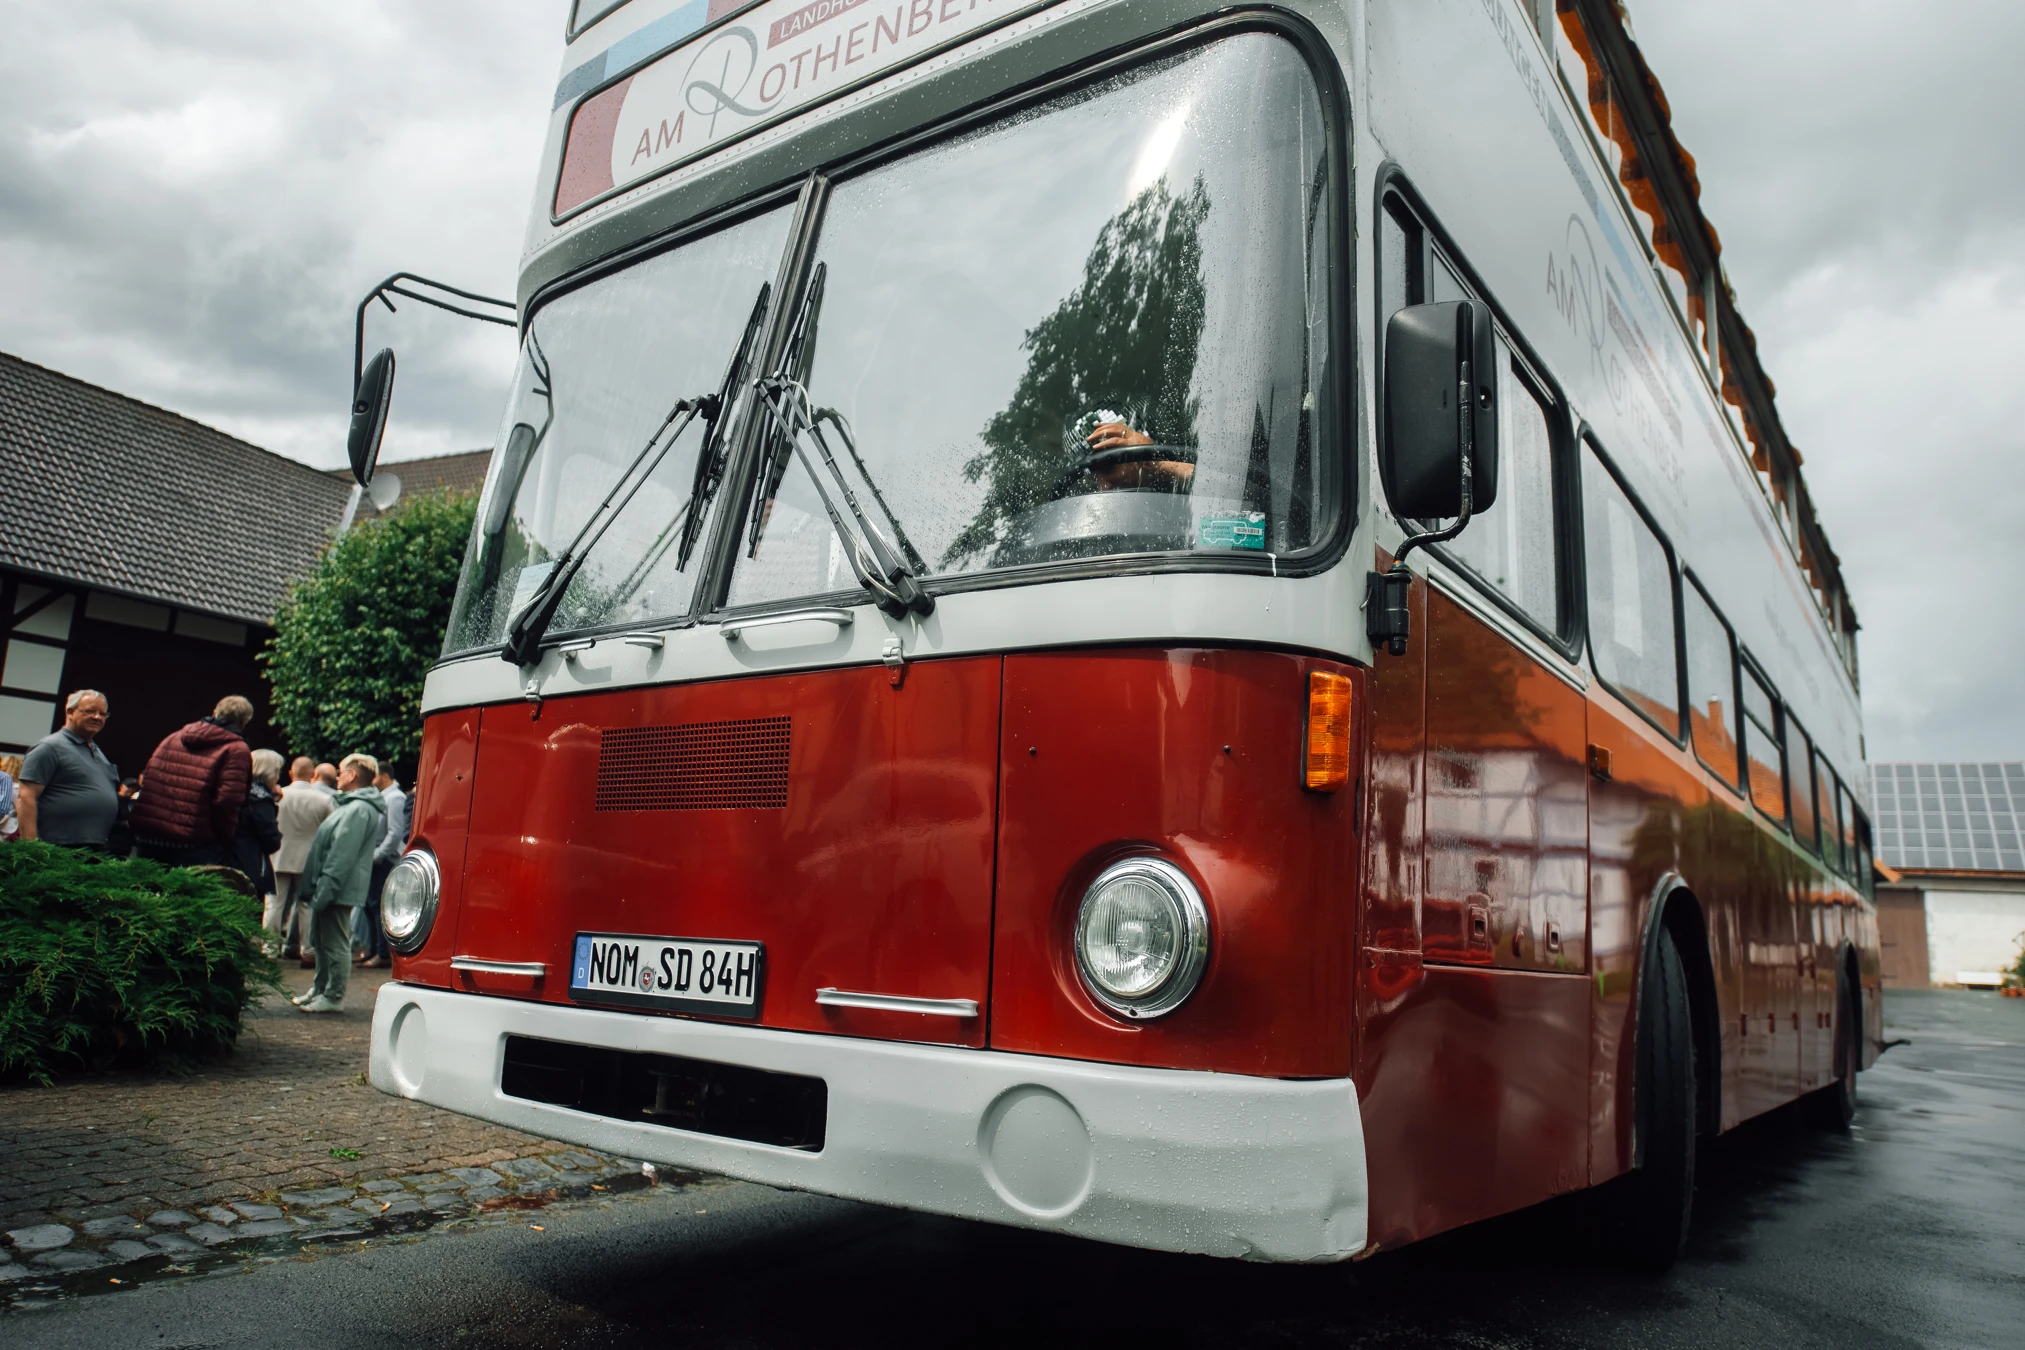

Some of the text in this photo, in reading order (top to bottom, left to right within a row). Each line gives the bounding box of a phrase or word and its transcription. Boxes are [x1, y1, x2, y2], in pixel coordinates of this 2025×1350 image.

[631, 0, 992, 166] AM ROTHENBE
[1547, 250, 1577, 337] AM
[577, 942, 755, 997] D NOM SD 84H
